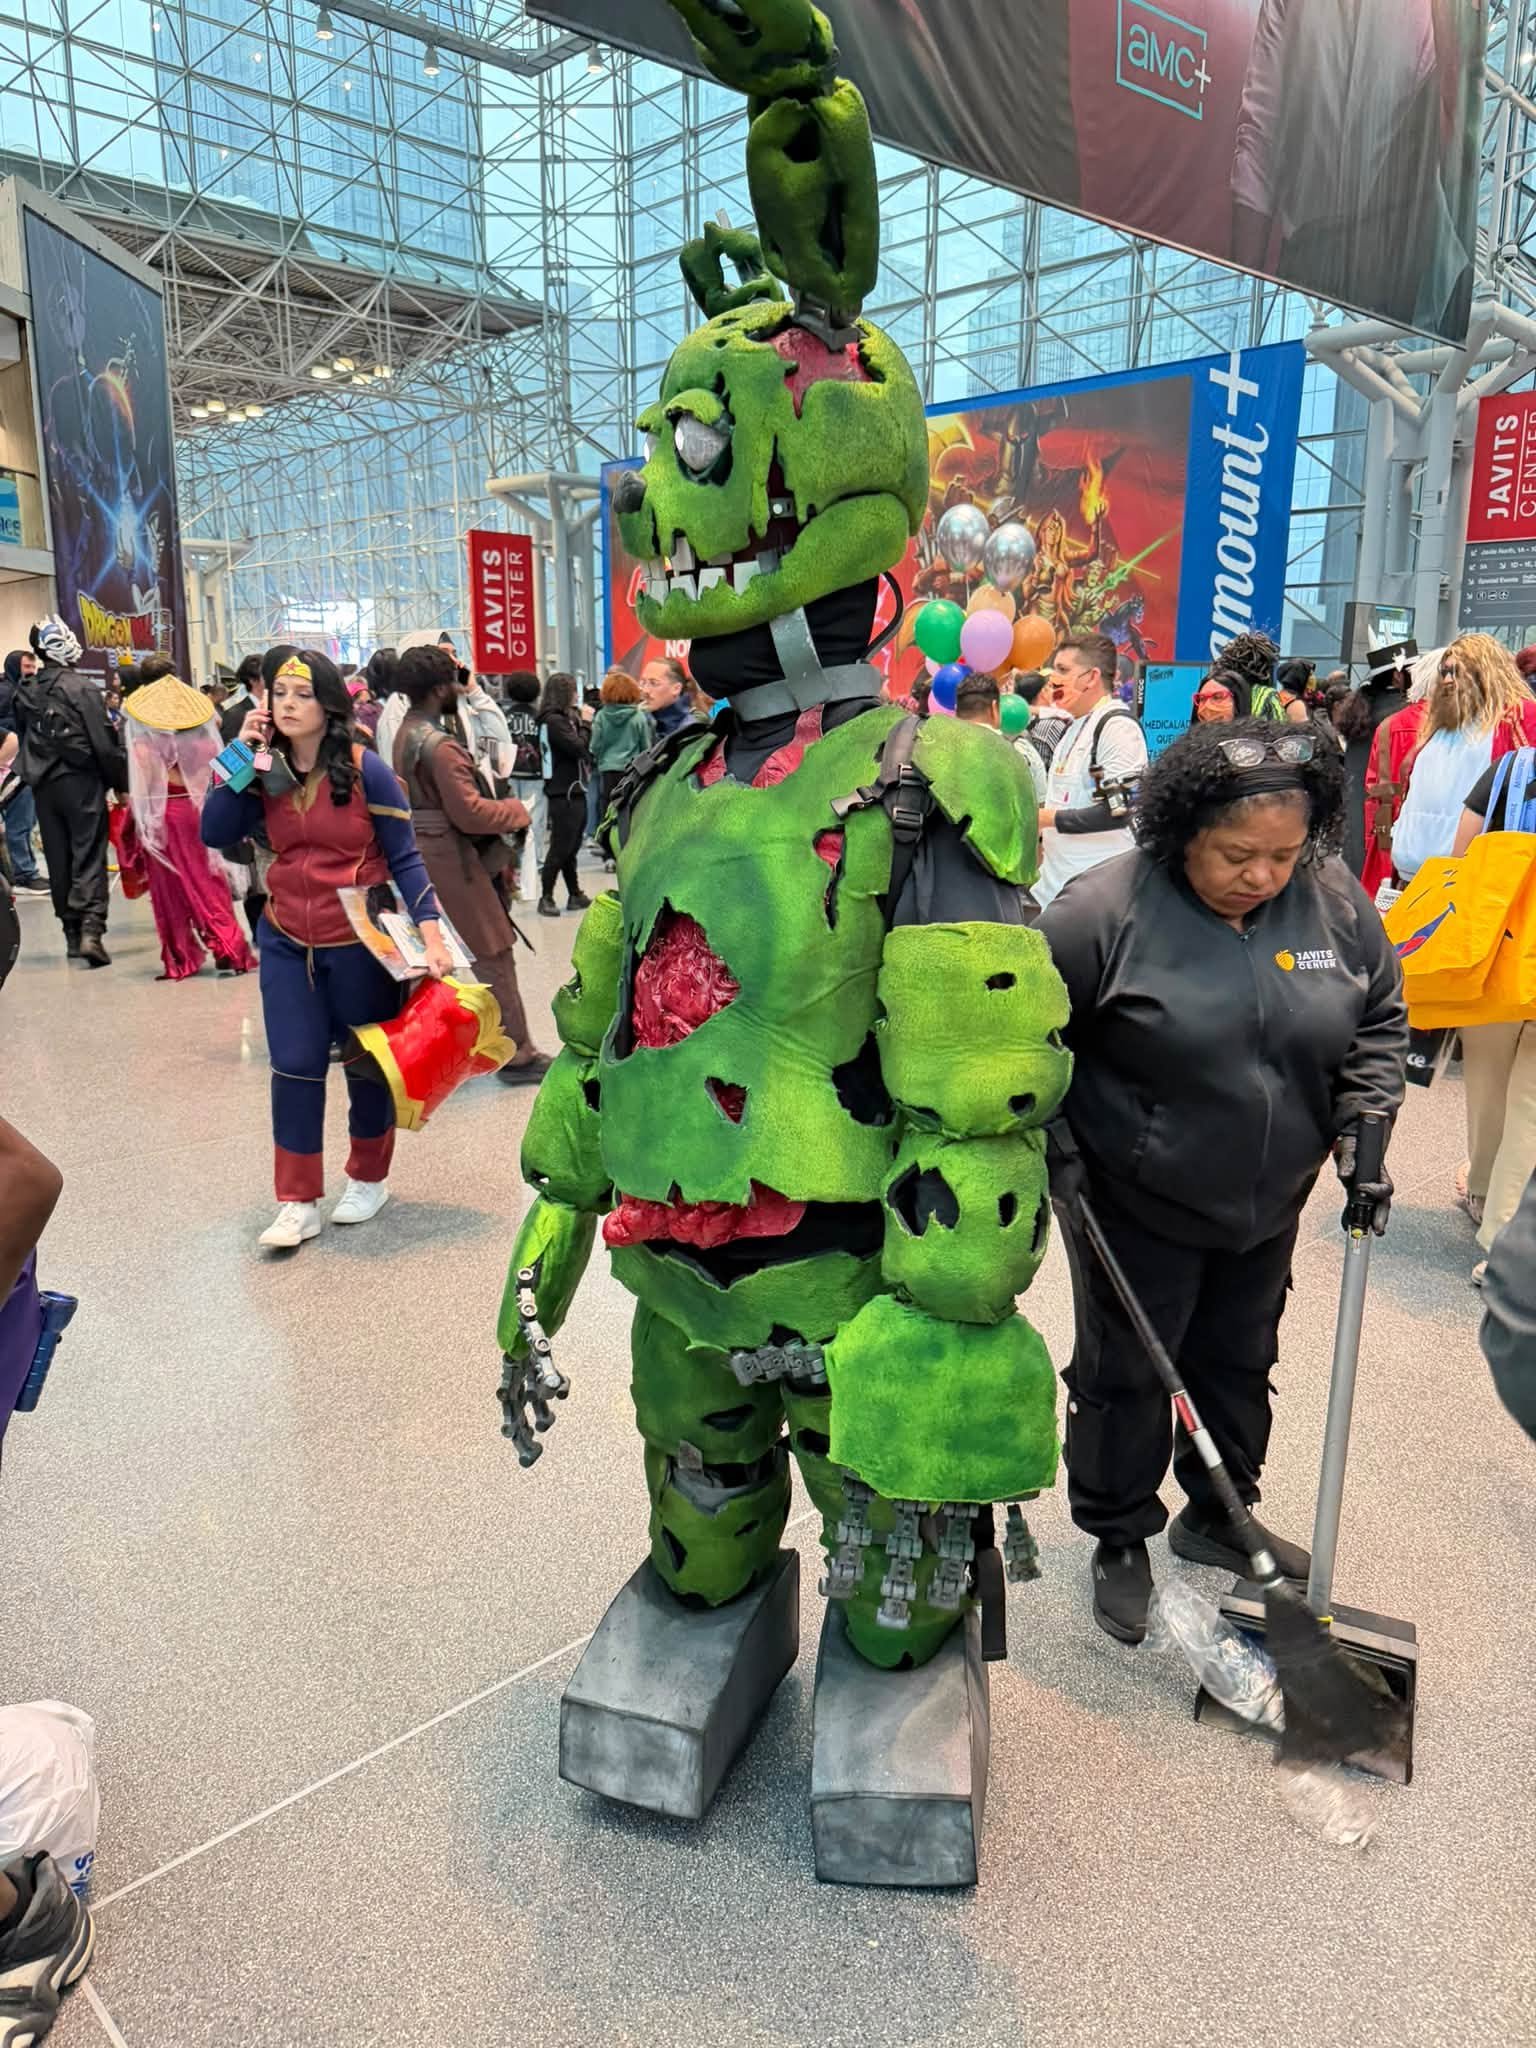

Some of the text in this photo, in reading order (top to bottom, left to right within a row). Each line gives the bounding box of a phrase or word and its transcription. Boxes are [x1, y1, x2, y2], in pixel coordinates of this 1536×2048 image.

[1487, 415, 1519, 519] JAVITS
[482, 549, 505, 654] JAVITS
[508, 551, 528, 657] CENTER
[1156, 734, 1175, 745] QUE
[1296, 949, 1334, 961] JAVITS
